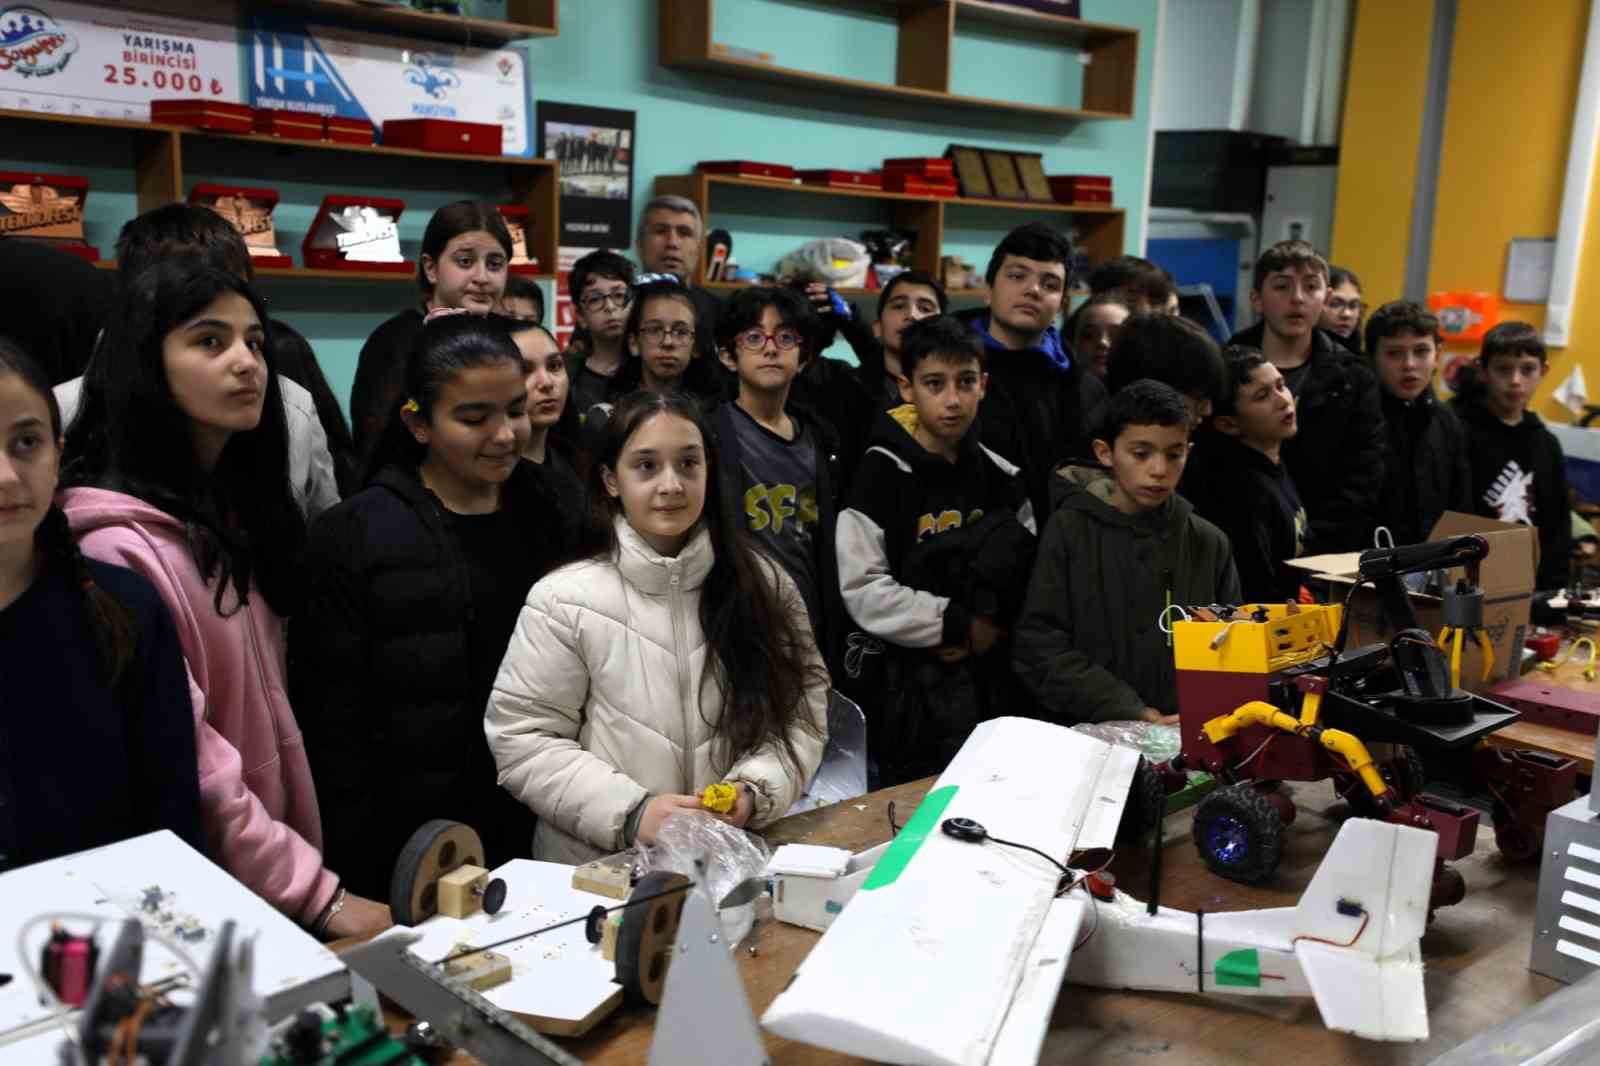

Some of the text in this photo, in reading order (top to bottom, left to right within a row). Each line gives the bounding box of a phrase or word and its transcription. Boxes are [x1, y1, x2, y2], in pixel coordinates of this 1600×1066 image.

[122, 34, 195, 54] YARIŞMA
[122, 49, 197, 70] BİRİNCİSİ
[103, 64, 202, 93] 25.000
